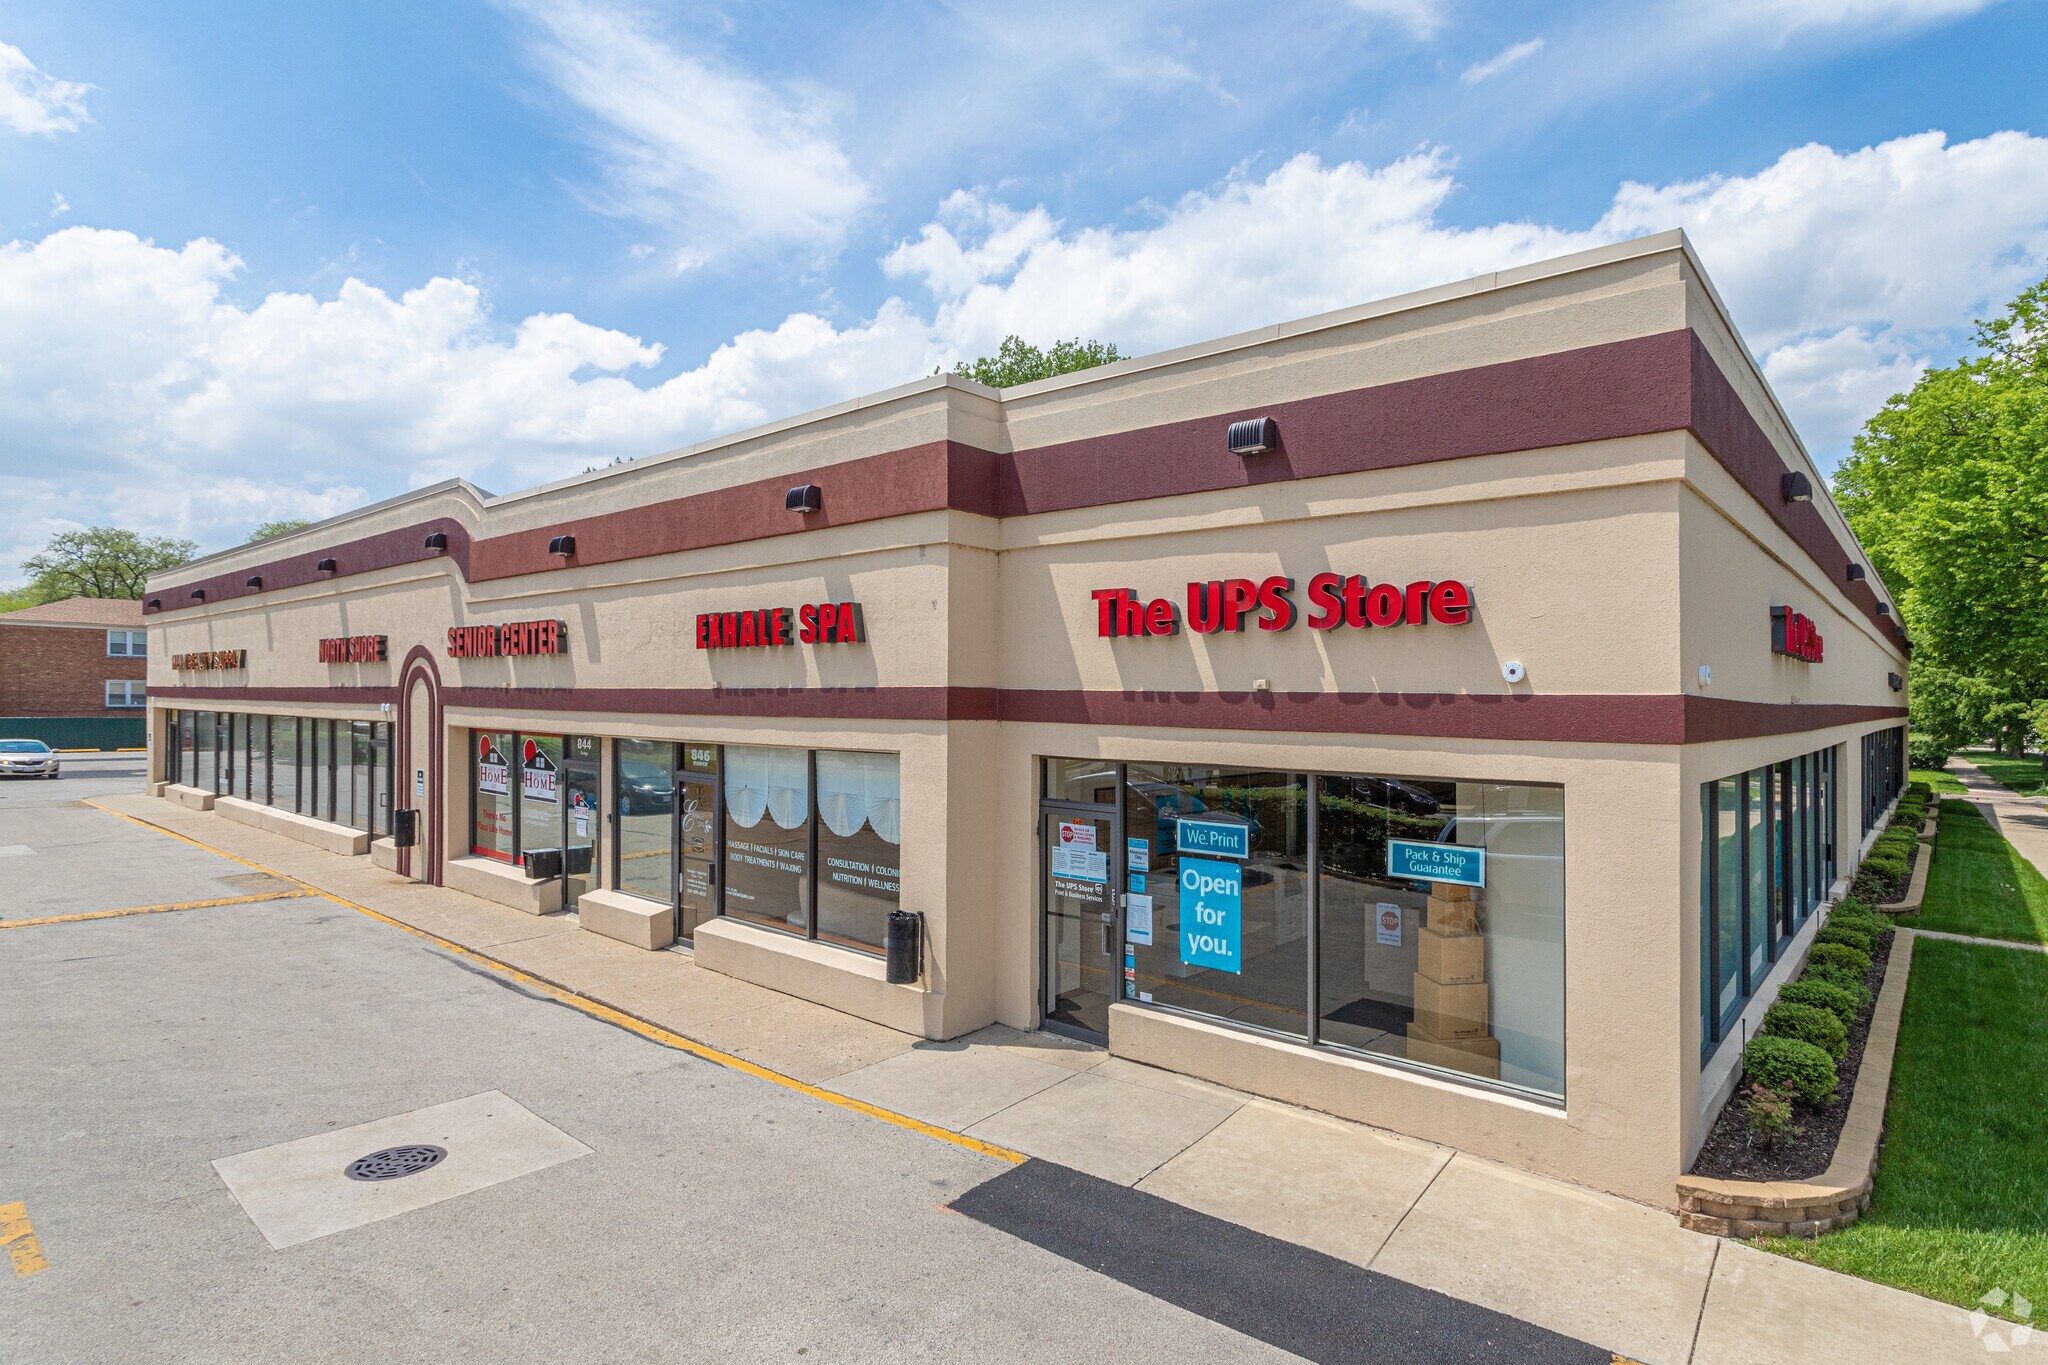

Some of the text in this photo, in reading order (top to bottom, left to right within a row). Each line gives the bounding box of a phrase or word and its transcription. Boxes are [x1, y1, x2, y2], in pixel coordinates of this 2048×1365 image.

[1091, 571, 1474, 638] The UPS Store
[696, 602, 866, 650] EXHALE SPA
[319, 635, 388, 663] NORTH SHORE
[447, 619, 567, 658] SENIOR CENTER
[578, 738, 592, 750] 844
[691, 748, 711, 762] 846
[727, 839, 805, 861] MASSAGE FACIALS SKIN CARE
[1187, 829, 1206, 845] We
[1209, 832, 1239, 849] Print
[729, 852, 802, 874] BODY TREATMENTS WAXING
[827, 857, 870, 873] CONSULTATION
[1405, 848, 1466, 868] Pack & Ship
[1409, 860, 1462, 877] Guarantee
[832, 871, 900, 893] NUTRITION WELLNESS
[1055, 880, 1066, 888] The
[1066, 882, 1078, 891] UPS
[1078, 884, 1095, 893] Store
[1182, 868, 1239, 897] Open
[1069, 892, 1086, 900] Business
[1086, 894, 1103, 903] Services
[1195, 901, 1226, 926] for
[1381, 916, 1399, 926] STOP
[1187, 933, 1232, 956] you.
